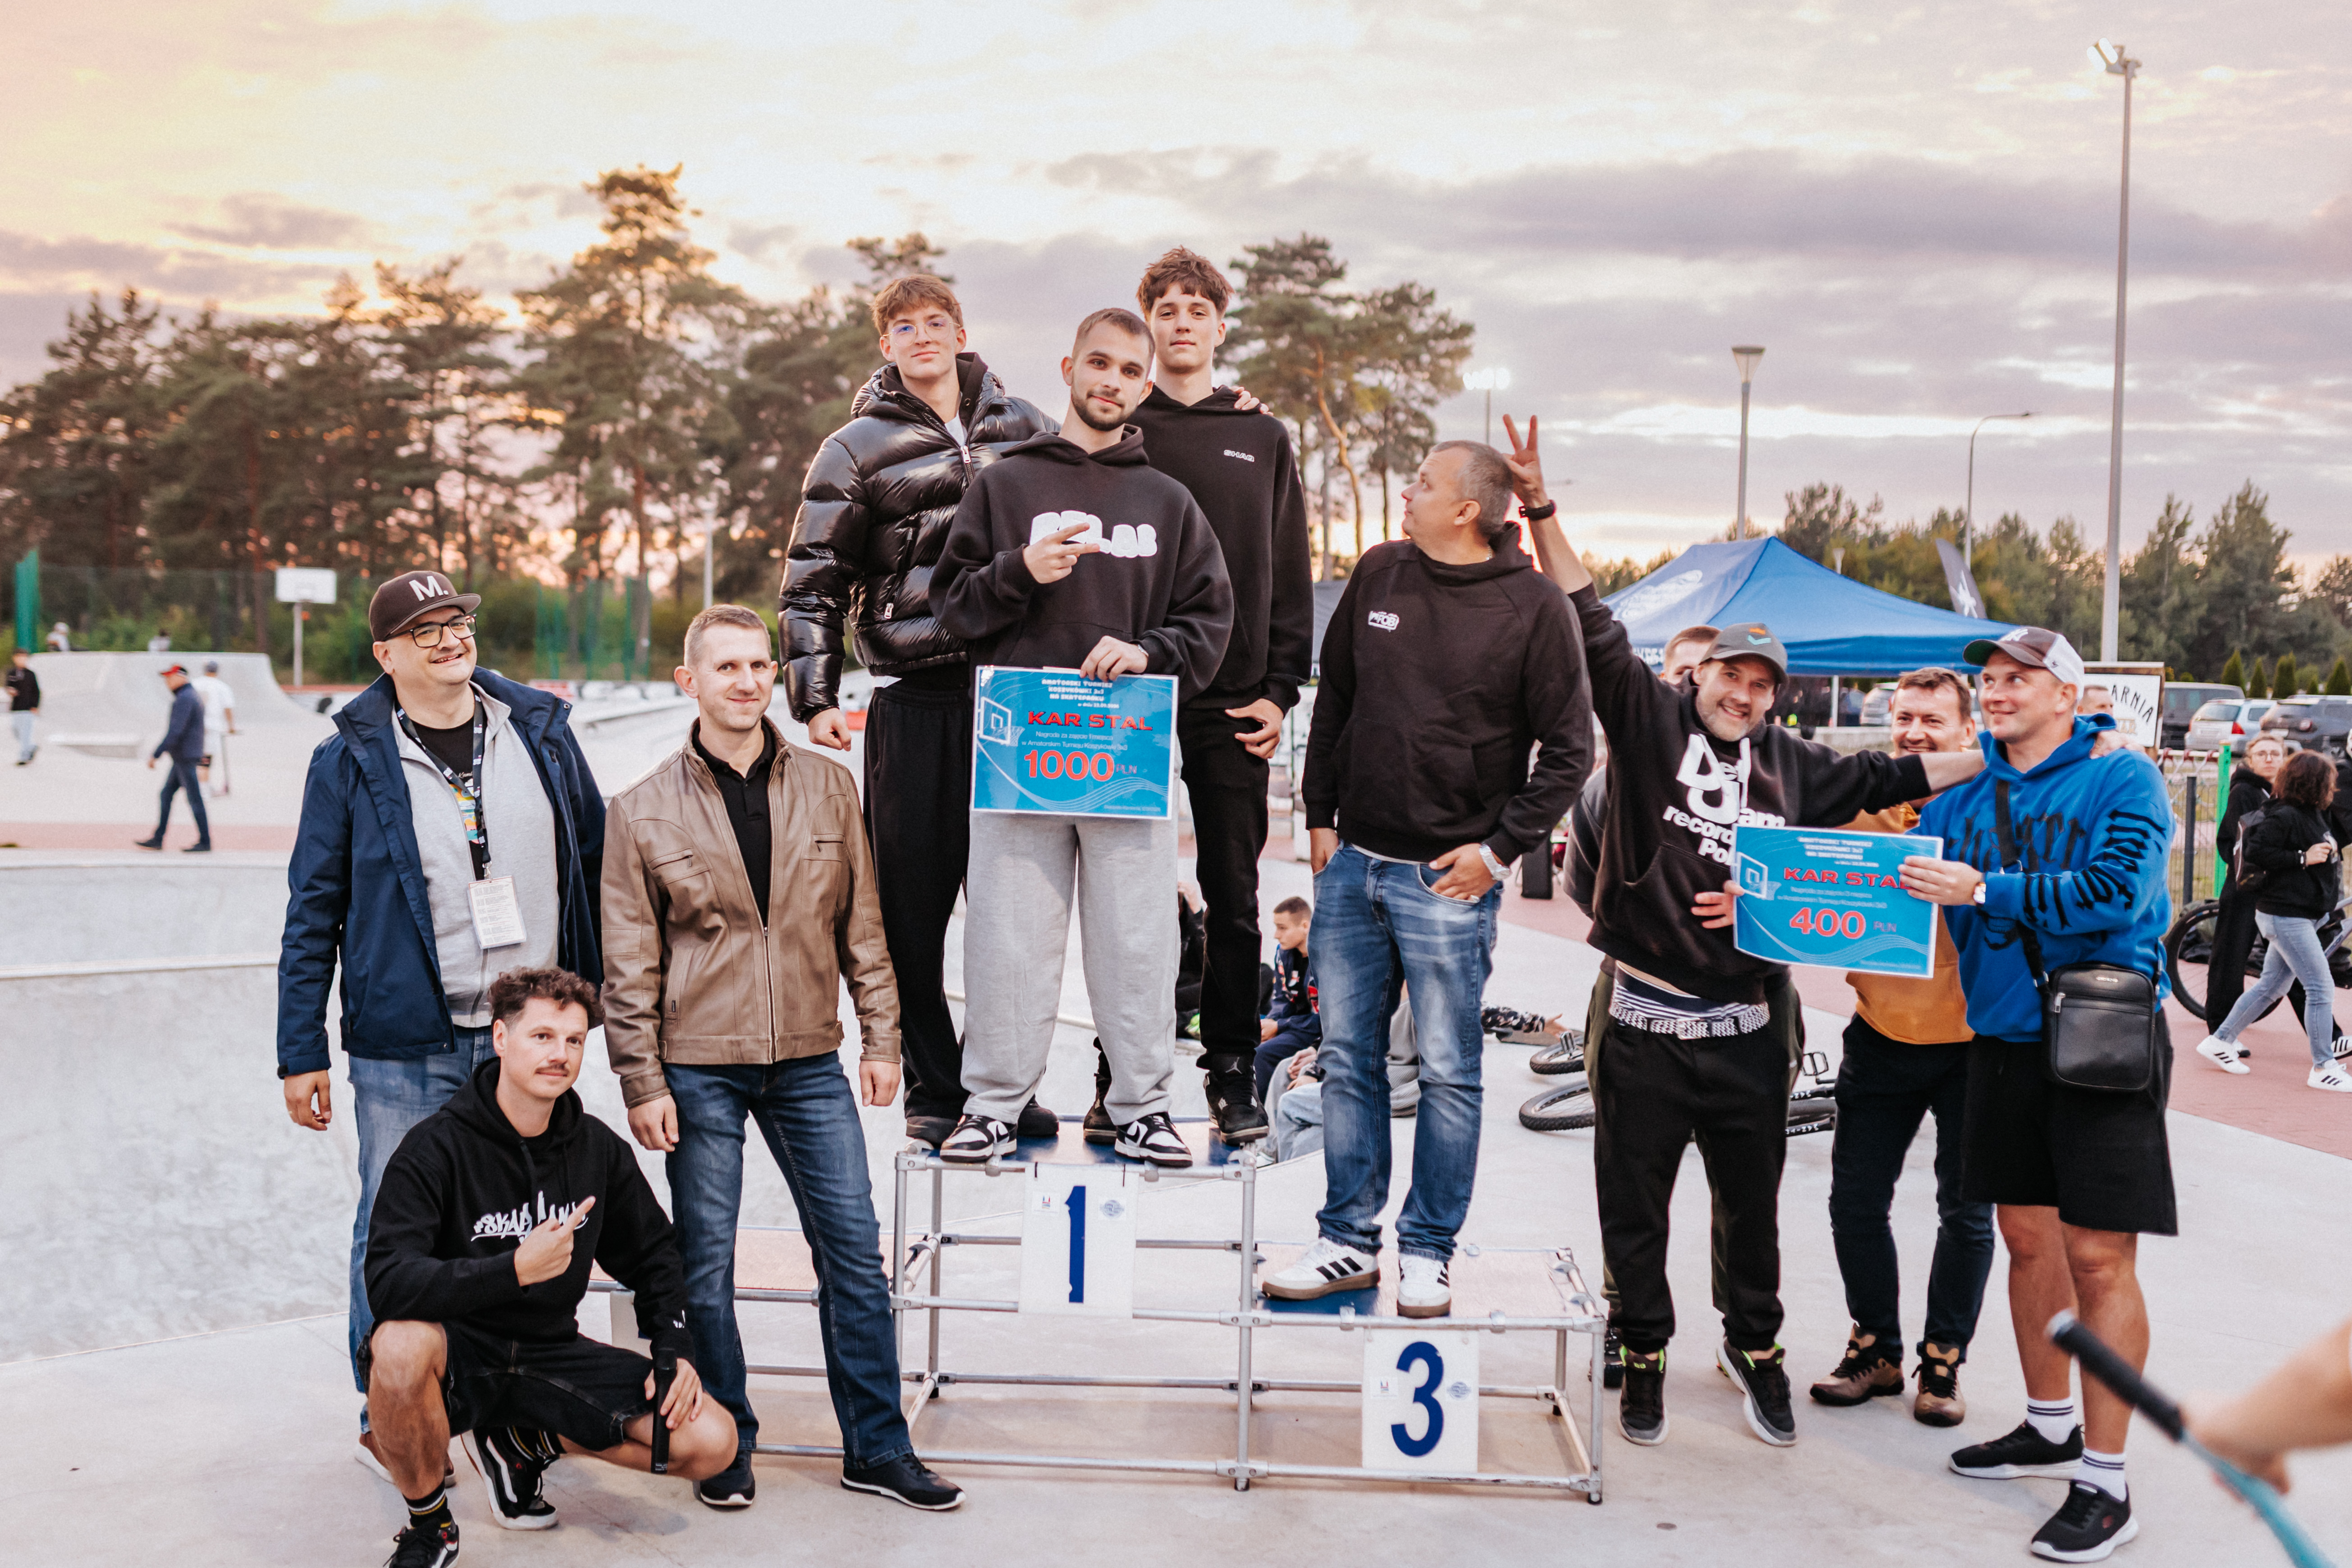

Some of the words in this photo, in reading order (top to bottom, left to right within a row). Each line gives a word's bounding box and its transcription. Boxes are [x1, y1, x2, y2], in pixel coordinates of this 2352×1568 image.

[1028, 711, 1081, 727] KAR
[1088, 714, 1153, 731] STAL
[1024, 750, 1114, 781] 1000
[1116, 763, 1137, 774] PLN
[1784, 867, 1839, 884] KAR
[1789, 908, 1866, 939] 400
[1065, 1185, 1086, 1303] 1
[1391, 1341, 1444, 1457] 3
